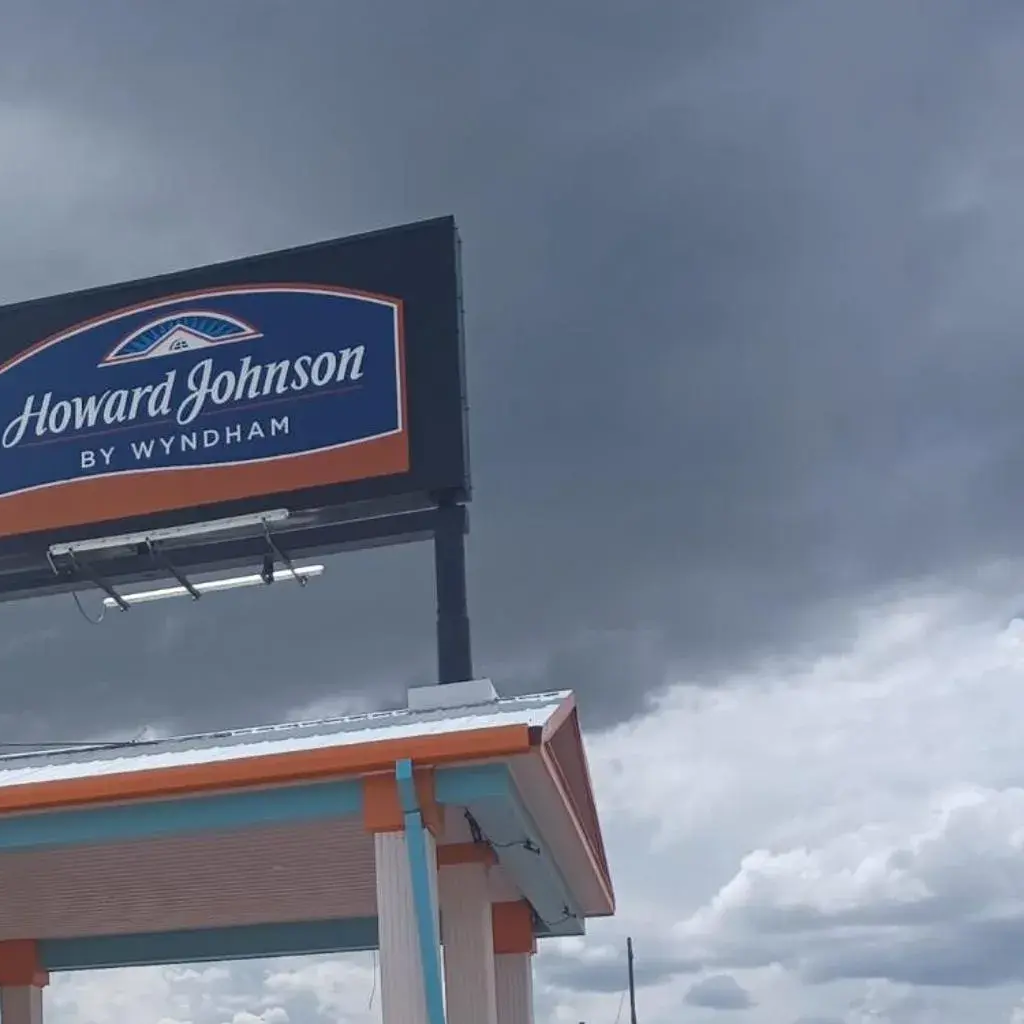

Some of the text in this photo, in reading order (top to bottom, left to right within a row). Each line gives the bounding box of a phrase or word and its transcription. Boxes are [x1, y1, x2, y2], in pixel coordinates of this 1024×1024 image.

[2, 344, 365, 449] Howard Johnson
[81, 415, 291, 468] BY WYNDHAM
